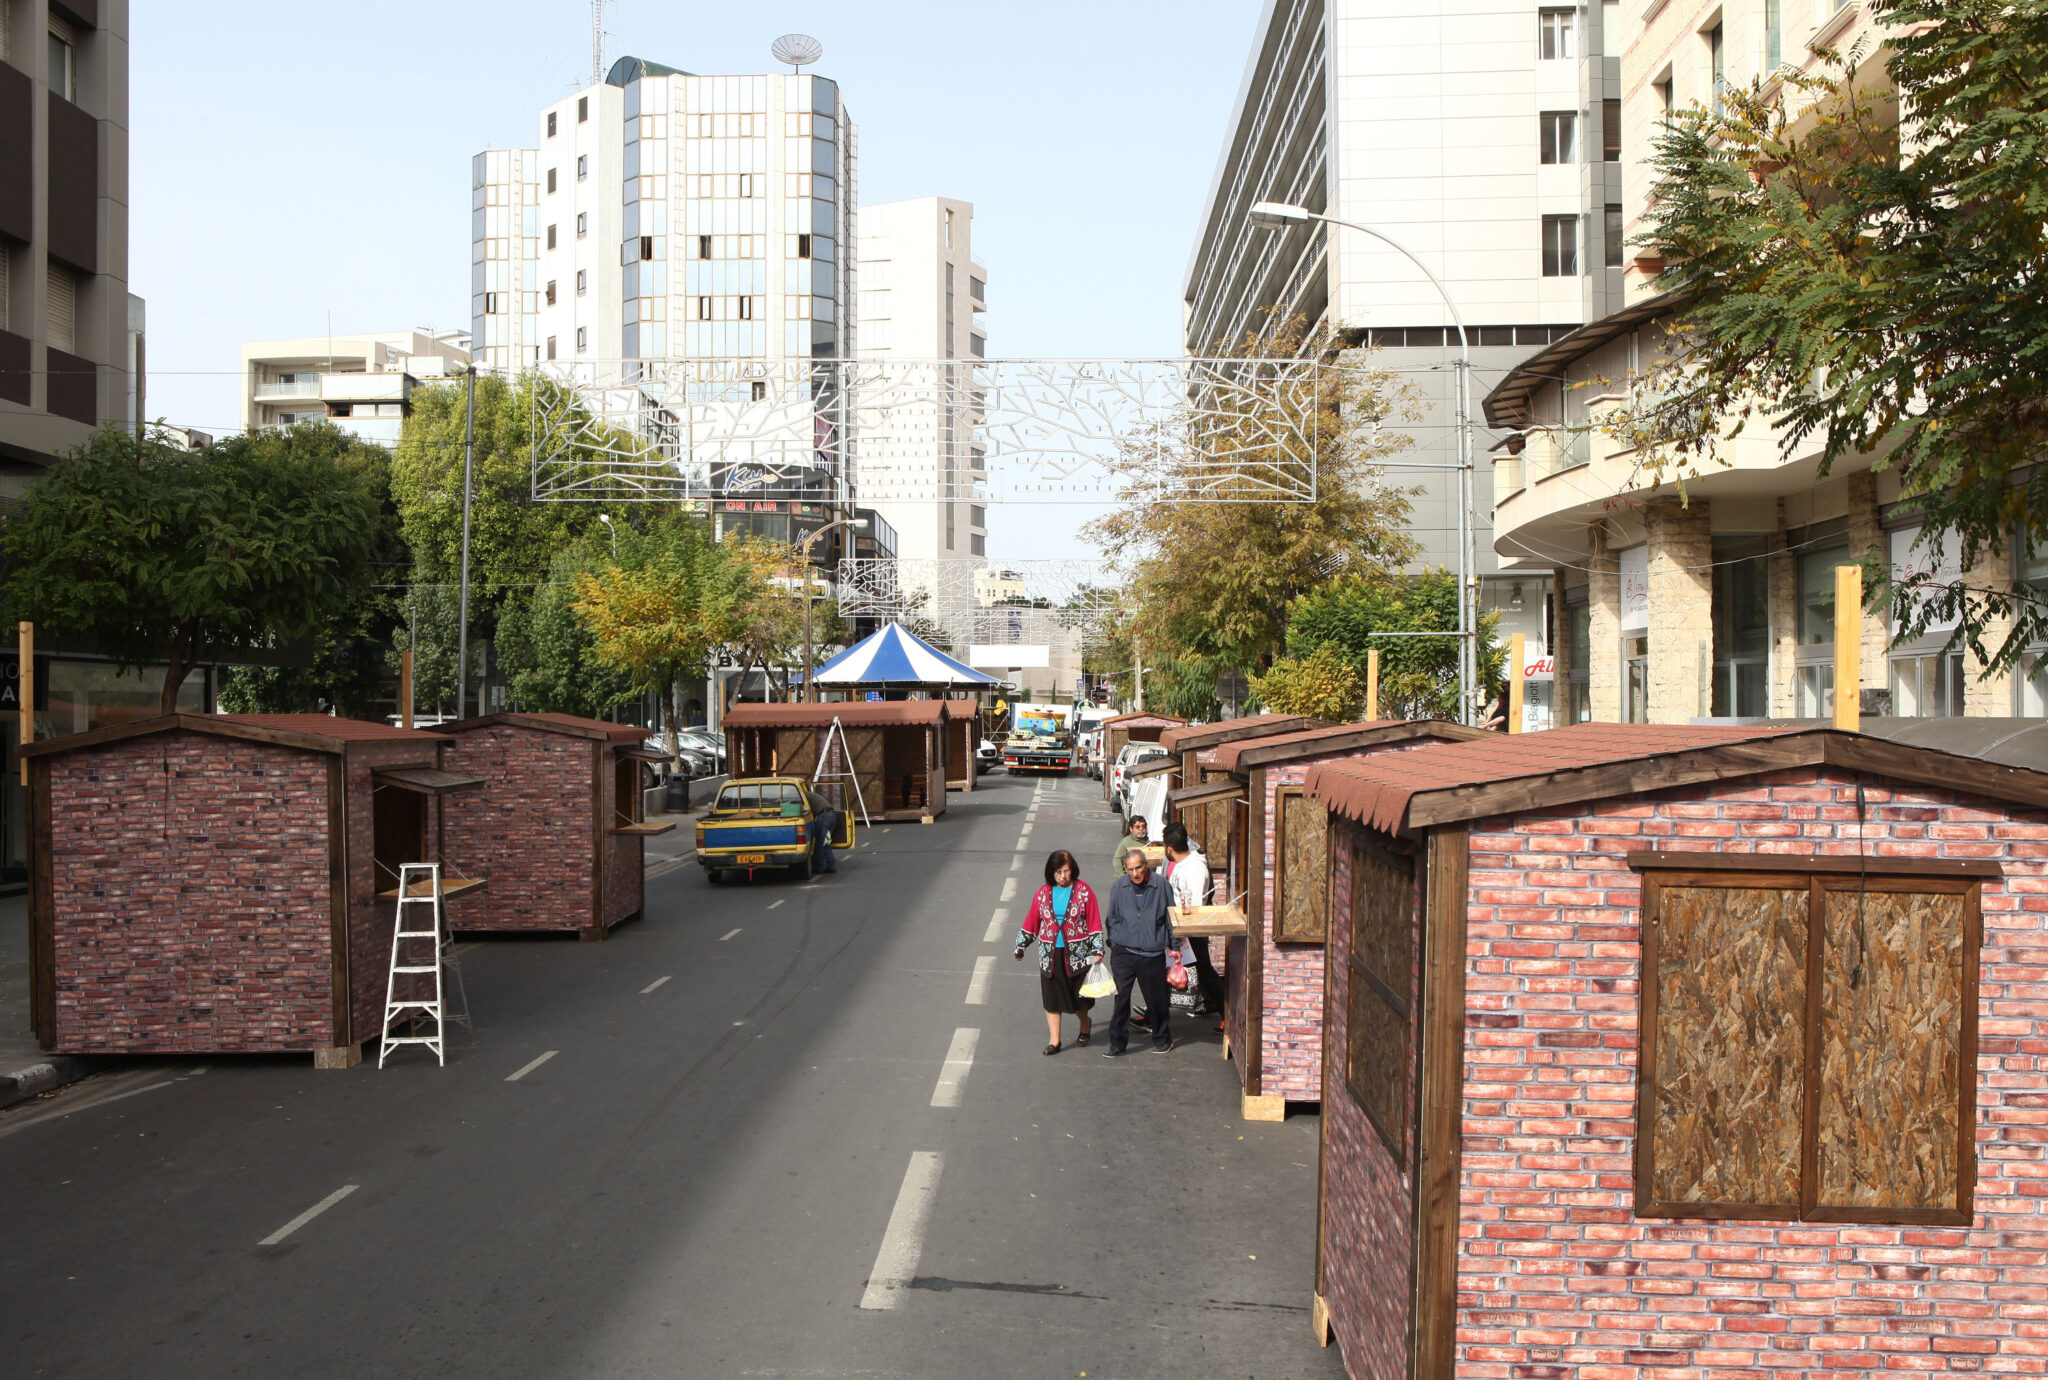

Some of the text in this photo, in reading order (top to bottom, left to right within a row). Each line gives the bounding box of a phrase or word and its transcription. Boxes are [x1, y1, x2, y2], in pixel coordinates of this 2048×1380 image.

[722, 465, 763, 495] Kiss
[726, 501, 777, 512] ON AIR
